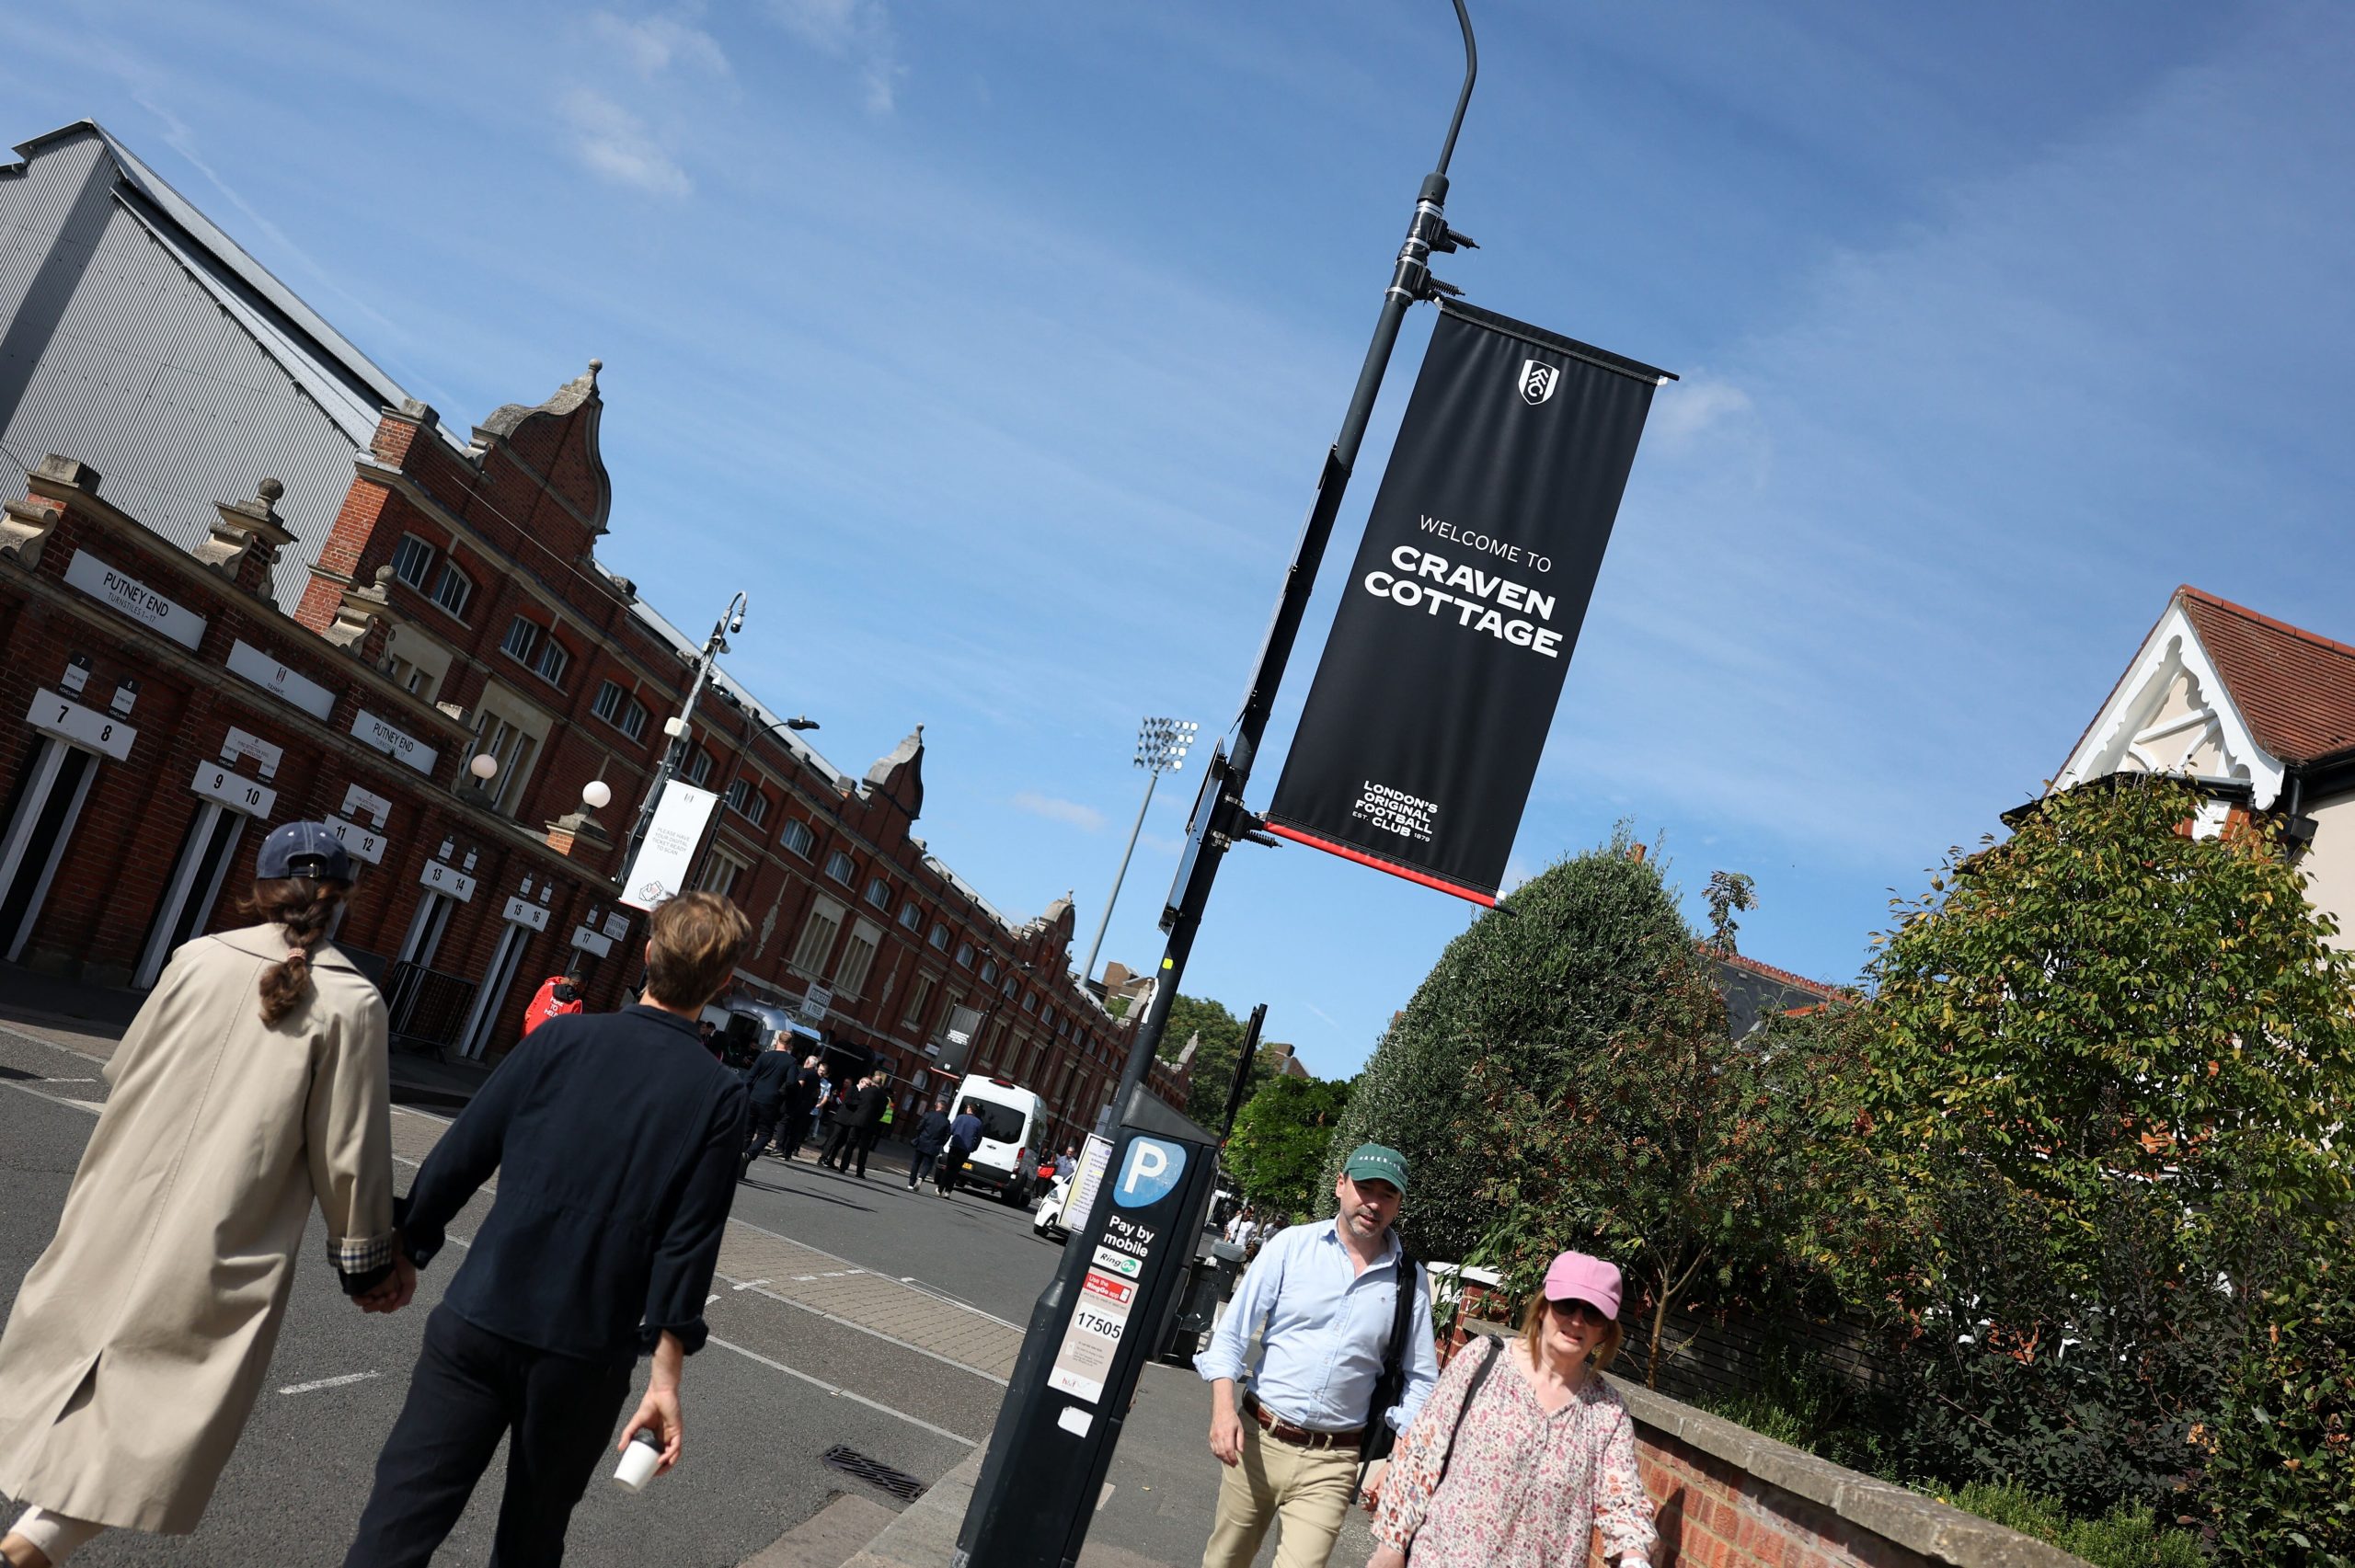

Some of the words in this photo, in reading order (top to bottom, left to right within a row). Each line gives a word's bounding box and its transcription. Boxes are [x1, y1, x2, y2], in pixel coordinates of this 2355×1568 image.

[1420, 515, 1522, 563] WELCOME
[1525, 552, 1551, 573] TO
[1391, 545, 1556, 621] CRAVEN
[103, 572, 147, 604] PUTNEY
[145, 596, 169, 617] END
[108, 592, 140, 615] TURNSTILES
[1364, 571, 1563, 658] COTTAGE
[79, 657, 86, 665] 7
[57, 704, 69, 723] 7
[101, 725, 112, 741] 8
[373, 723, 399, 745] PUTNEY
[399, 738, 414, 752] END
[213, 774, 224, 789] 9
[246, 787, 259, 806] 10
[1363, 780, 1438, 813] LONDON'S
[1364, 793, 1430, 823] ORIGINAL
[1355, 800, 1432, 834] FOOTBALL
[337, 826, 346, 841] 11
[657, 828, 675, 837] PLEASE
[677, 833, 690, 841] HAVE
[1352, 811, 1369, 821] EST.
[1373, 817, 1411, 837] CLUB
[1414, 832, 1430, 842] 1879
[362, 837, 373, 852] 12
[653, 837, 669, 846] TICKET
[670, 843, 686, 852] READY
[669, 837, 688, 846] DIGITAL
[432, 868, 442, 881] 13
[455, 878, 465, 892] 14
[514, 904, 523, 916] 15
[533, 910, 540, 922] 16
[582, 933, 591, 944] 17
[550, 997, 564, 1007] HERE
[550, 1003, 557, 1012] TO
[1123, 1140, 1167, 1194] P
[1109, 1215, 1135, 1236] Pay
[1137, 1226, 1155, 1243] by
[1104, 1232, 1148, 1257] mobile
[1089, 1276, 1099, 1284] Use
[1086, 1282, 1109, 1295] RingGo
[1109, 1291, 1120, 1299] app
[1078, 1312, 1122, 1339] 17505
